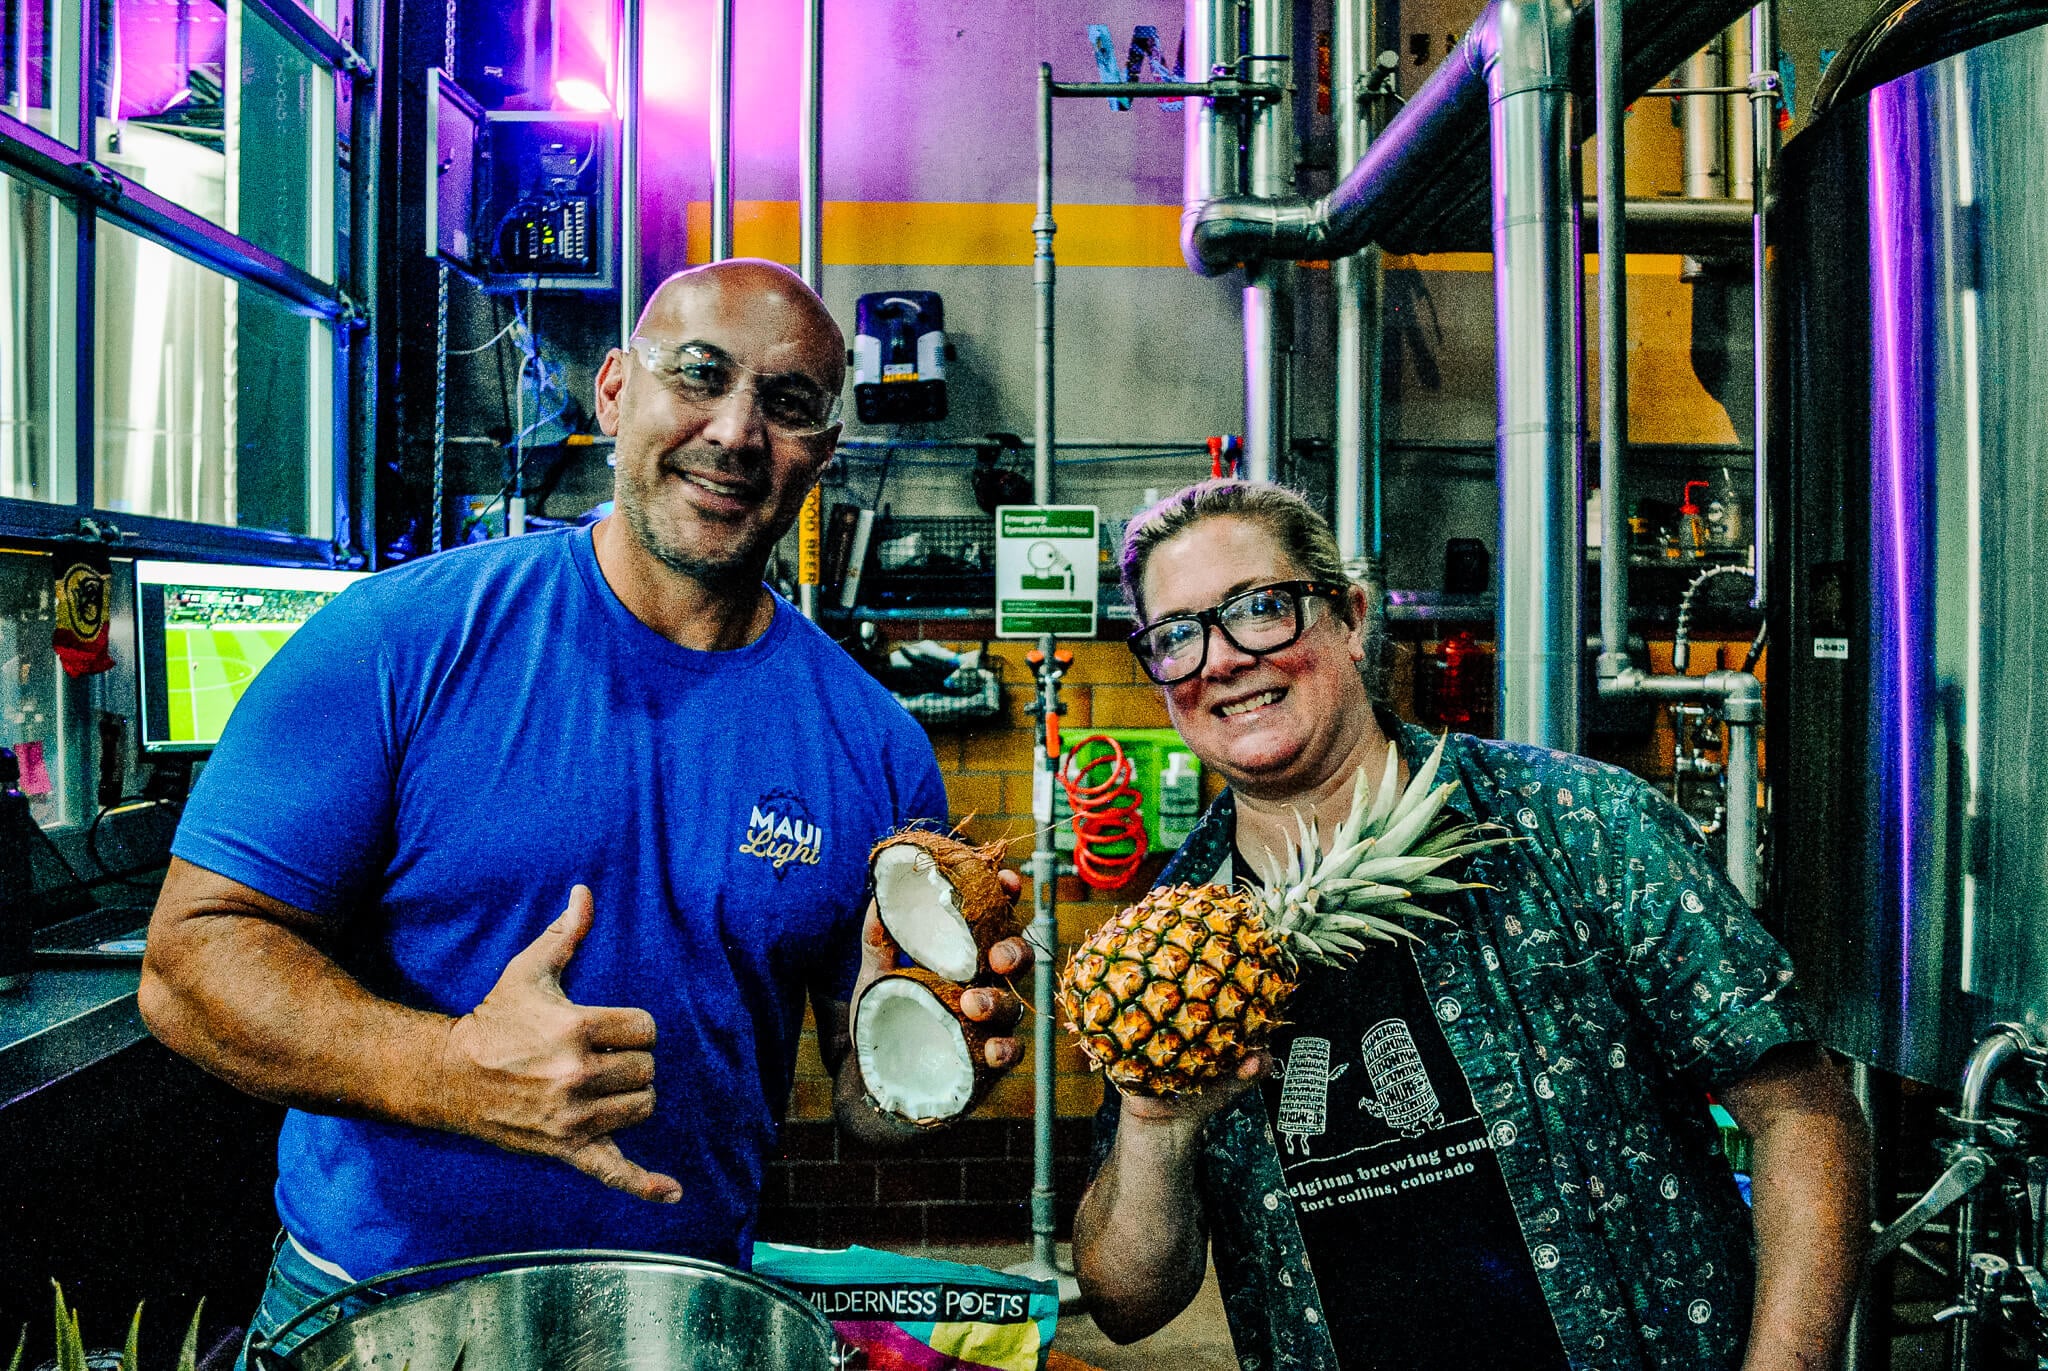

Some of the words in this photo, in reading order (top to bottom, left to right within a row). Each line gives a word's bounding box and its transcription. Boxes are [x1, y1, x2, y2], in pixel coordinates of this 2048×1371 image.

[803, 484, 818, 532] OOD
[739, 829, 821, 868] Light
[749, 805, 822, 849] MAUI
[1289, 1173, 1354, 1197] elgium
[1356, 1149, 1441, 1180] brewing
[1300, 1196, 1335, 1212] fort
[1337, 1184, 1398, 1204] collins,
[1401, 1162, 1475, 1189] colorado
[945, 1291, 1023, 1317] POETS
